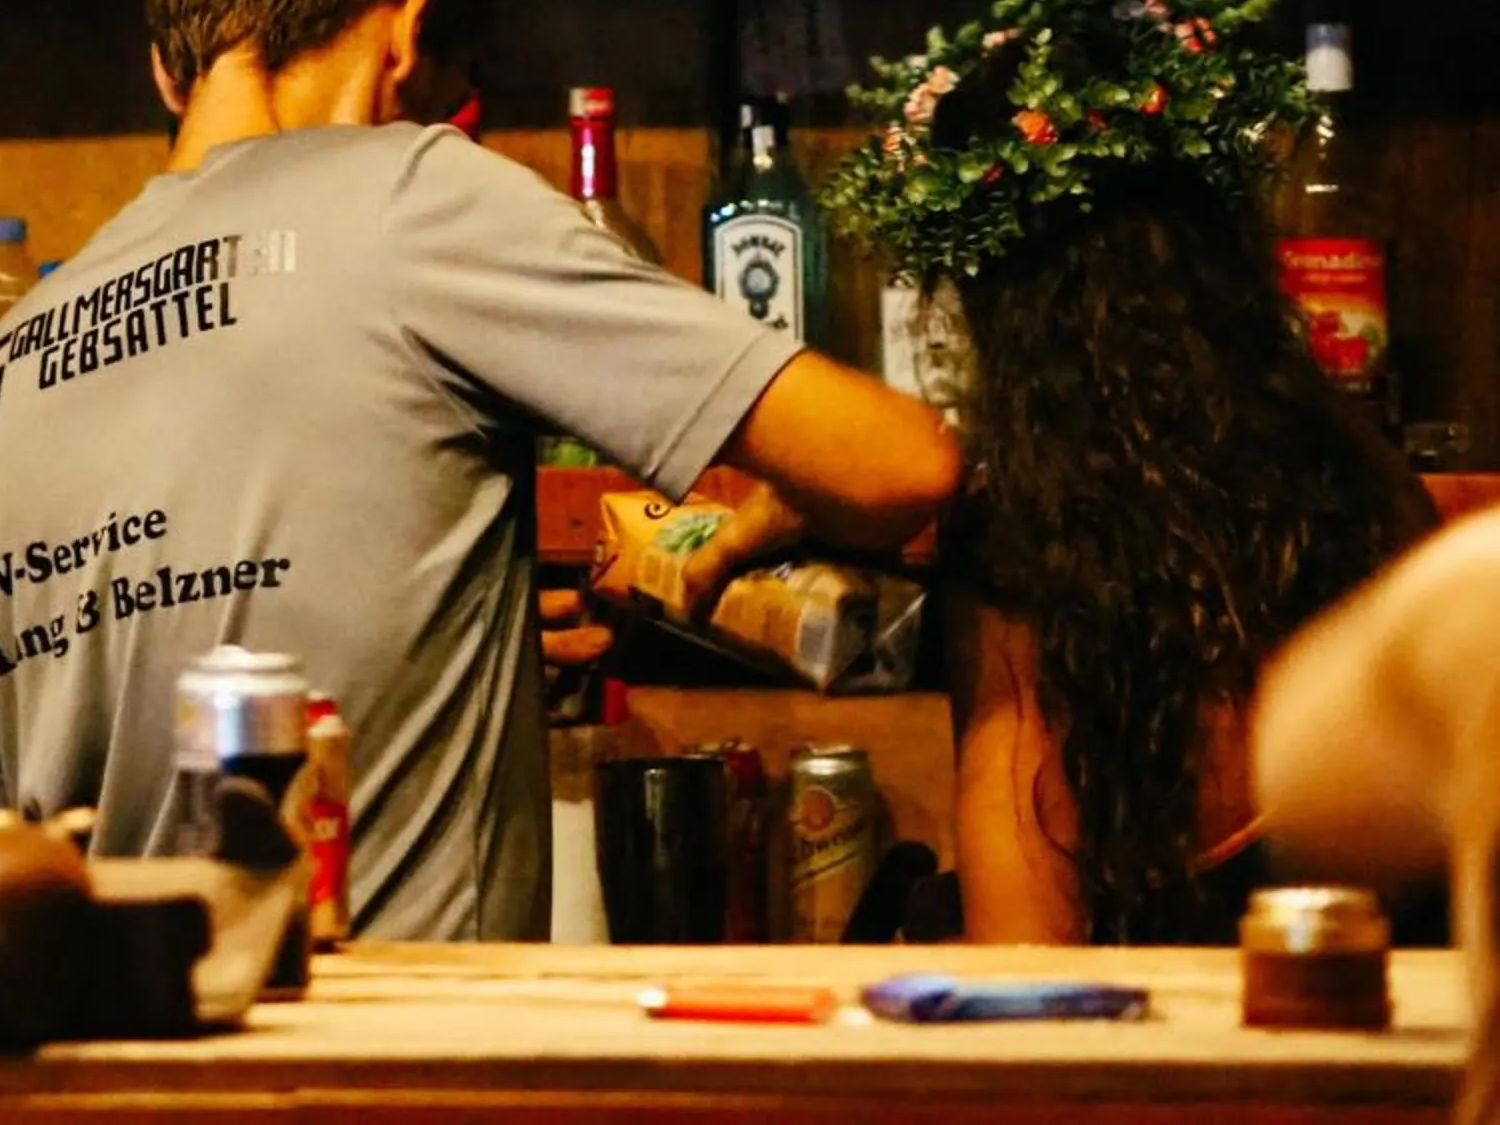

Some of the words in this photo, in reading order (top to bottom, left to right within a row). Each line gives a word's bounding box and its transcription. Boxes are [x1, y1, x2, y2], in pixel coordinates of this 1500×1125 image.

[8, 230, 297, 363] GALLMERSGARTN
[38, 282, 238, 391] GEBSATTEL
[111, 556, 290, 620] Belzner
